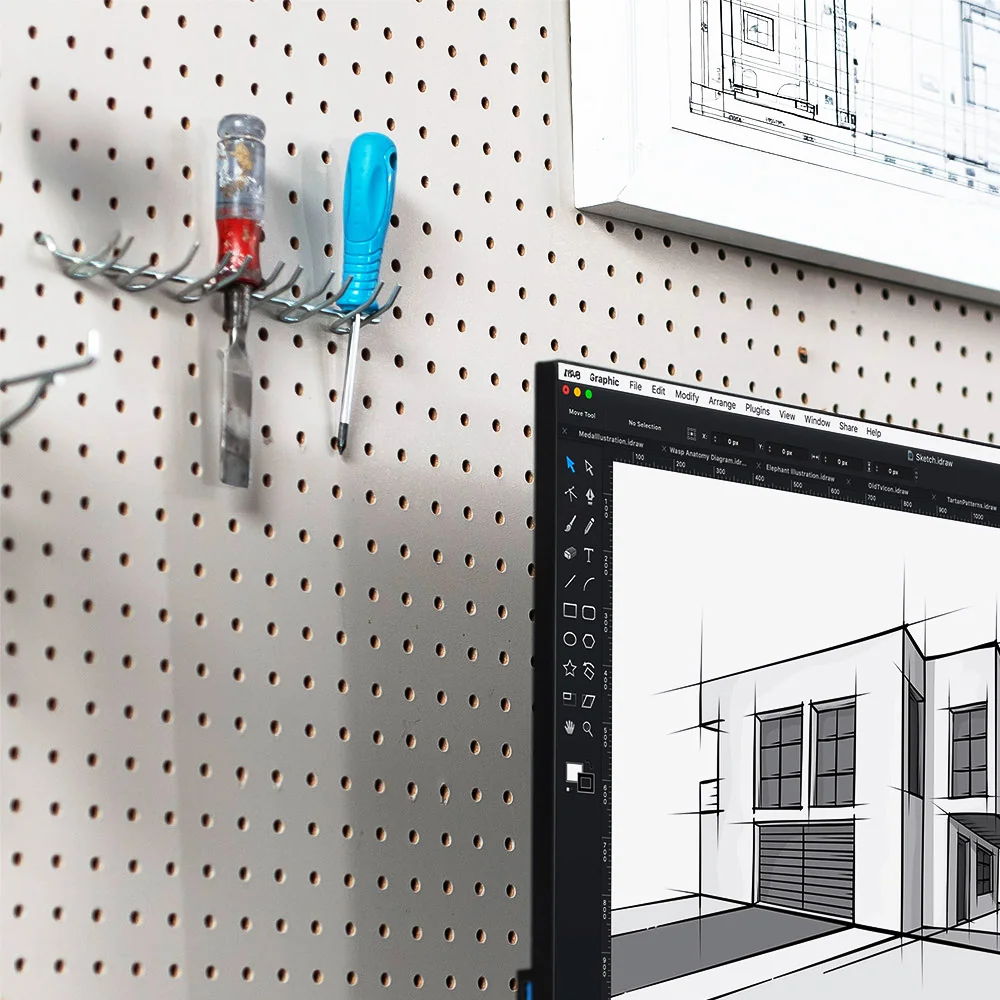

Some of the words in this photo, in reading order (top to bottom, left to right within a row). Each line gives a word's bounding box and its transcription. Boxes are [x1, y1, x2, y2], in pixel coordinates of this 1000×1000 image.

[590, 373, 620, 386] Graphic
[630, 381, 642, 391] File
[652, 385, 666, 396] Edit
[675, 390, 699, 403] Modify
[708, 396, 736, 410] Arrange
[746, 404, 770, 418] Plugins
[779, 410, 796, 421] View
[804, 415, 830, 428] Window
[839, 422, 858, 433] Share
[866, 426, 882, 438] Help
[568, 408, 583, 417] Move
[584, 411, 596, 419] Tool
[637, 421, 661, 431] Selection
[669, 446, 684, 456] Wasp
[686, 450, 710, 461] Anatomy
[916, 453, 954, 468] Sketch.idraw
[766, 464, 790, 474] Elephant
[947, 496, 997, 511] TartanPatterns.idraw
